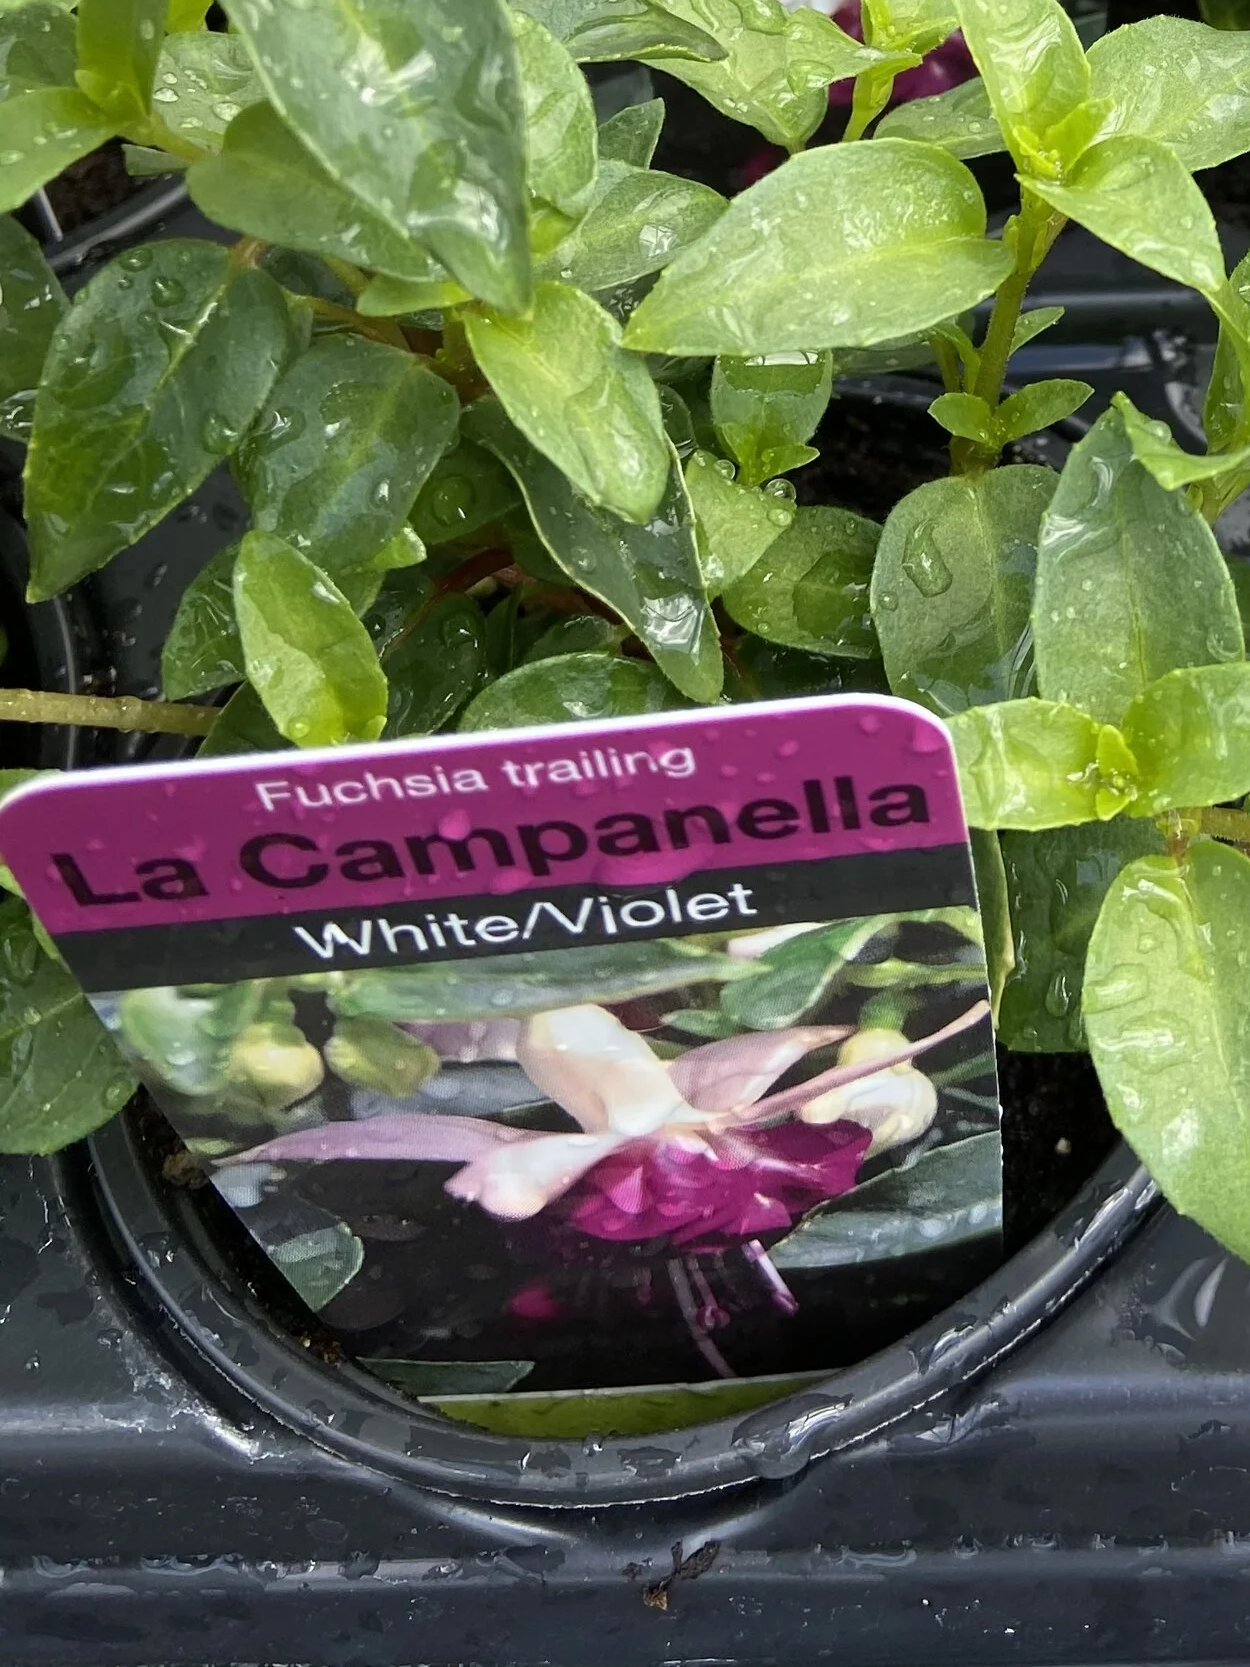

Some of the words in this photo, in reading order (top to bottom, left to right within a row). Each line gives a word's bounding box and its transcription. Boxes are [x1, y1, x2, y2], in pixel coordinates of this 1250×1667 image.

[255, 766, 490, 812] Fuchsia
[502, 742, 697, 786] trailing
[52, 851, 206, 908] La
[236, 775, 930, 890] Campanella
[293, 882, 758, 963] White/Violet
